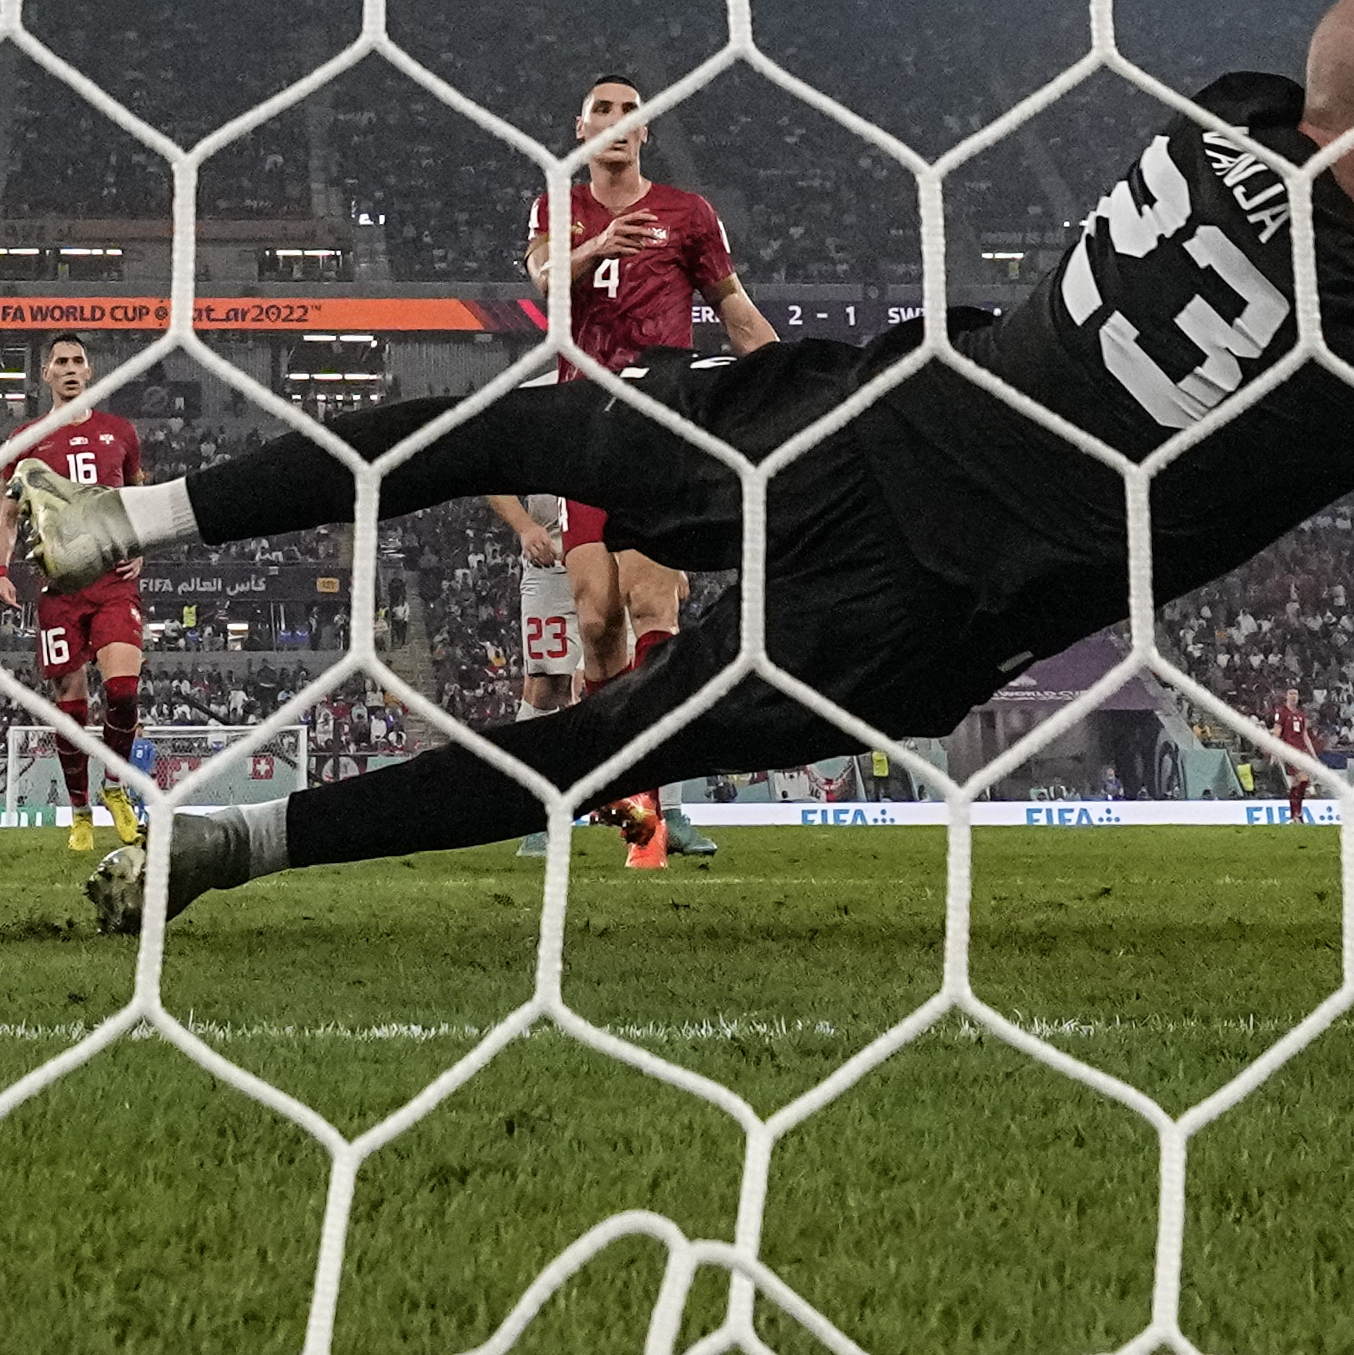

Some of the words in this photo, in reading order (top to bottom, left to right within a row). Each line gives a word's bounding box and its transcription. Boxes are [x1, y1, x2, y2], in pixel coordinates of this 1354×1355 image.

[1202, 126, 1292, 244] VANJA
[593, 258, 620, 298] 4
[30, 305, 106, 323] WORLD
[109, 305, 150, 323] CUP
[788, 306, 804, 325] 2
[845, 306, 856, 326] 1
[66, 452, 98, 485] 16
[139, 579, 174, 592] FIFA
[178, 578, 222, 594] العالم
[226, 575, 267, 596] كأس
[40, 625, 70, 667] 16
[527, 615, 568, 660] 23
[801, 809, 868, 825] FIFA
[1026, 809, 1094, 825] FIFA
